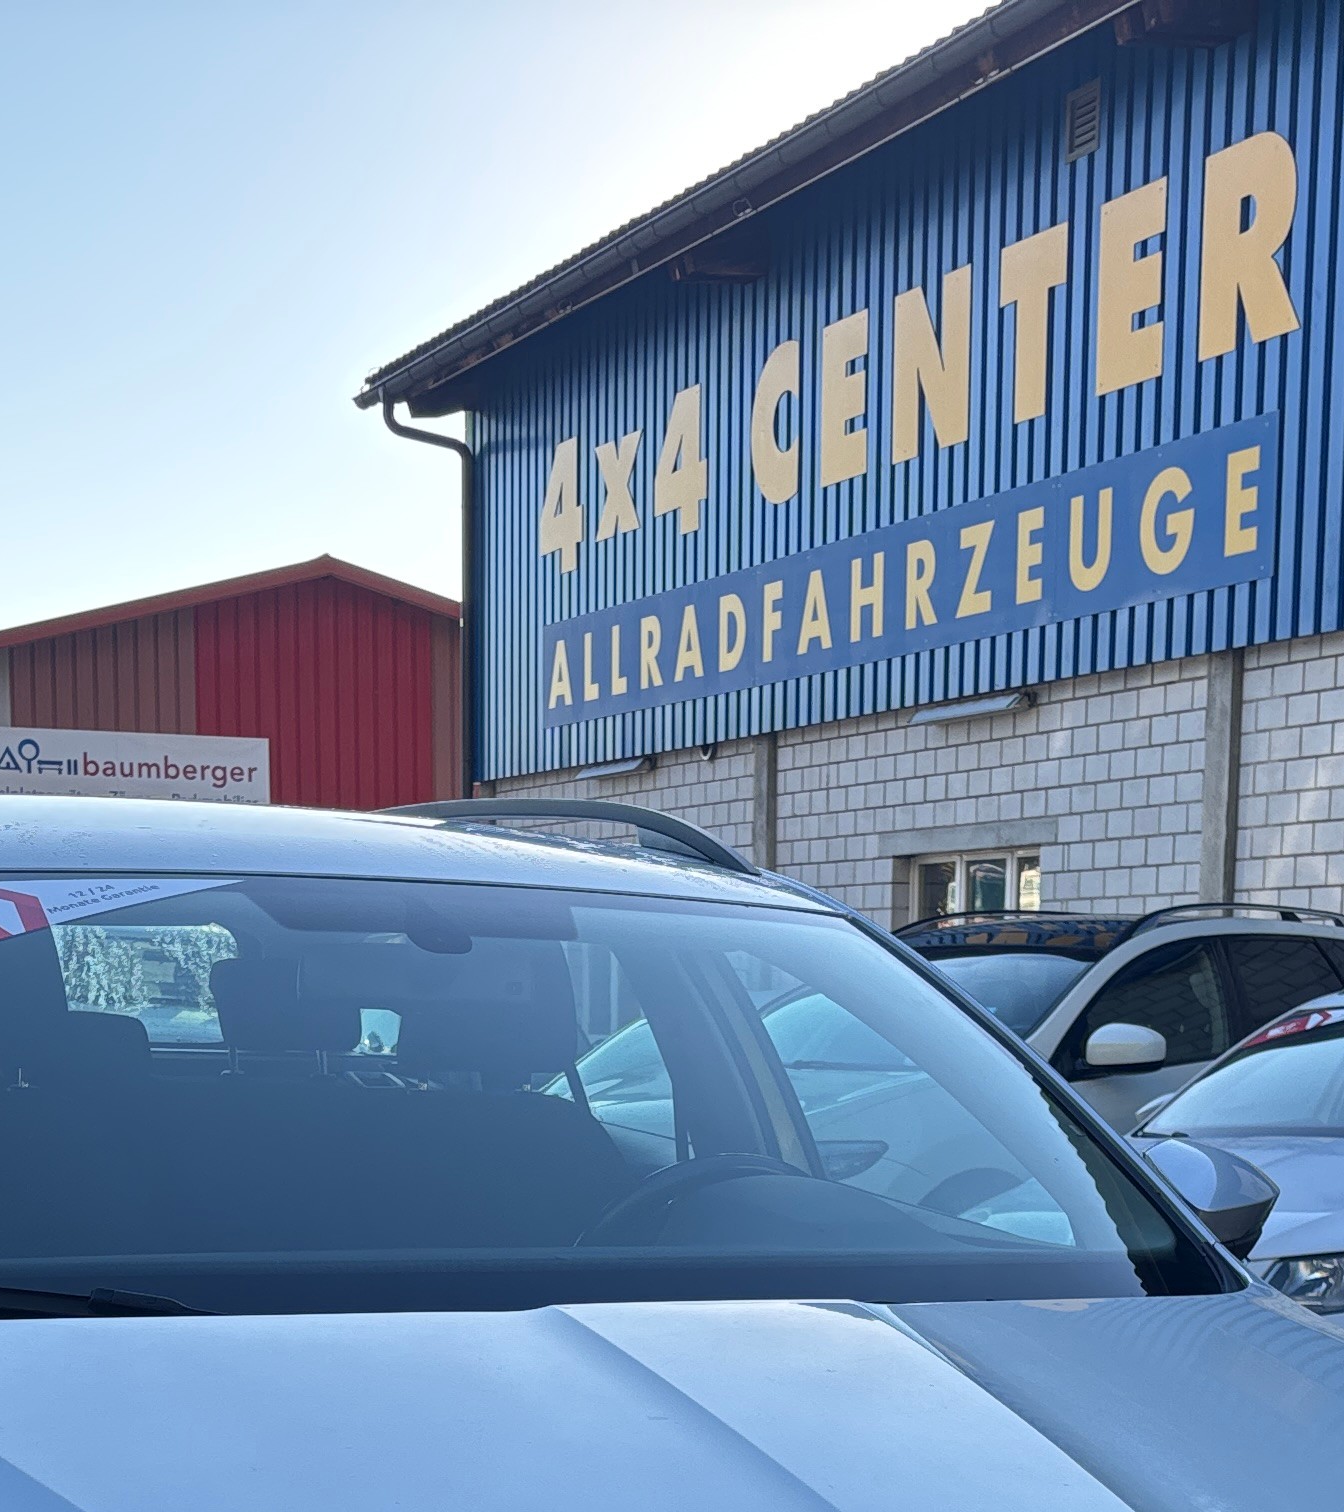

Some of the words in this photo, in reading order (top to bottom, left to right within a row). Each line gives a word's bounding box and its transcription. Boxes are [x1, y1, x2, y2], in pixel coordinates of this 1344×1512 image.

[539, 384, 709, 574] 4x4
[750, 131, 1300, 504] CENTER
[547, 445, 1262, 710] ALLRADFAHRZEUGE
[83, 752, 257, 788] baumberger
[46, 898, 100, 914] Monate
[100, 884, 161, 901] Garantie
